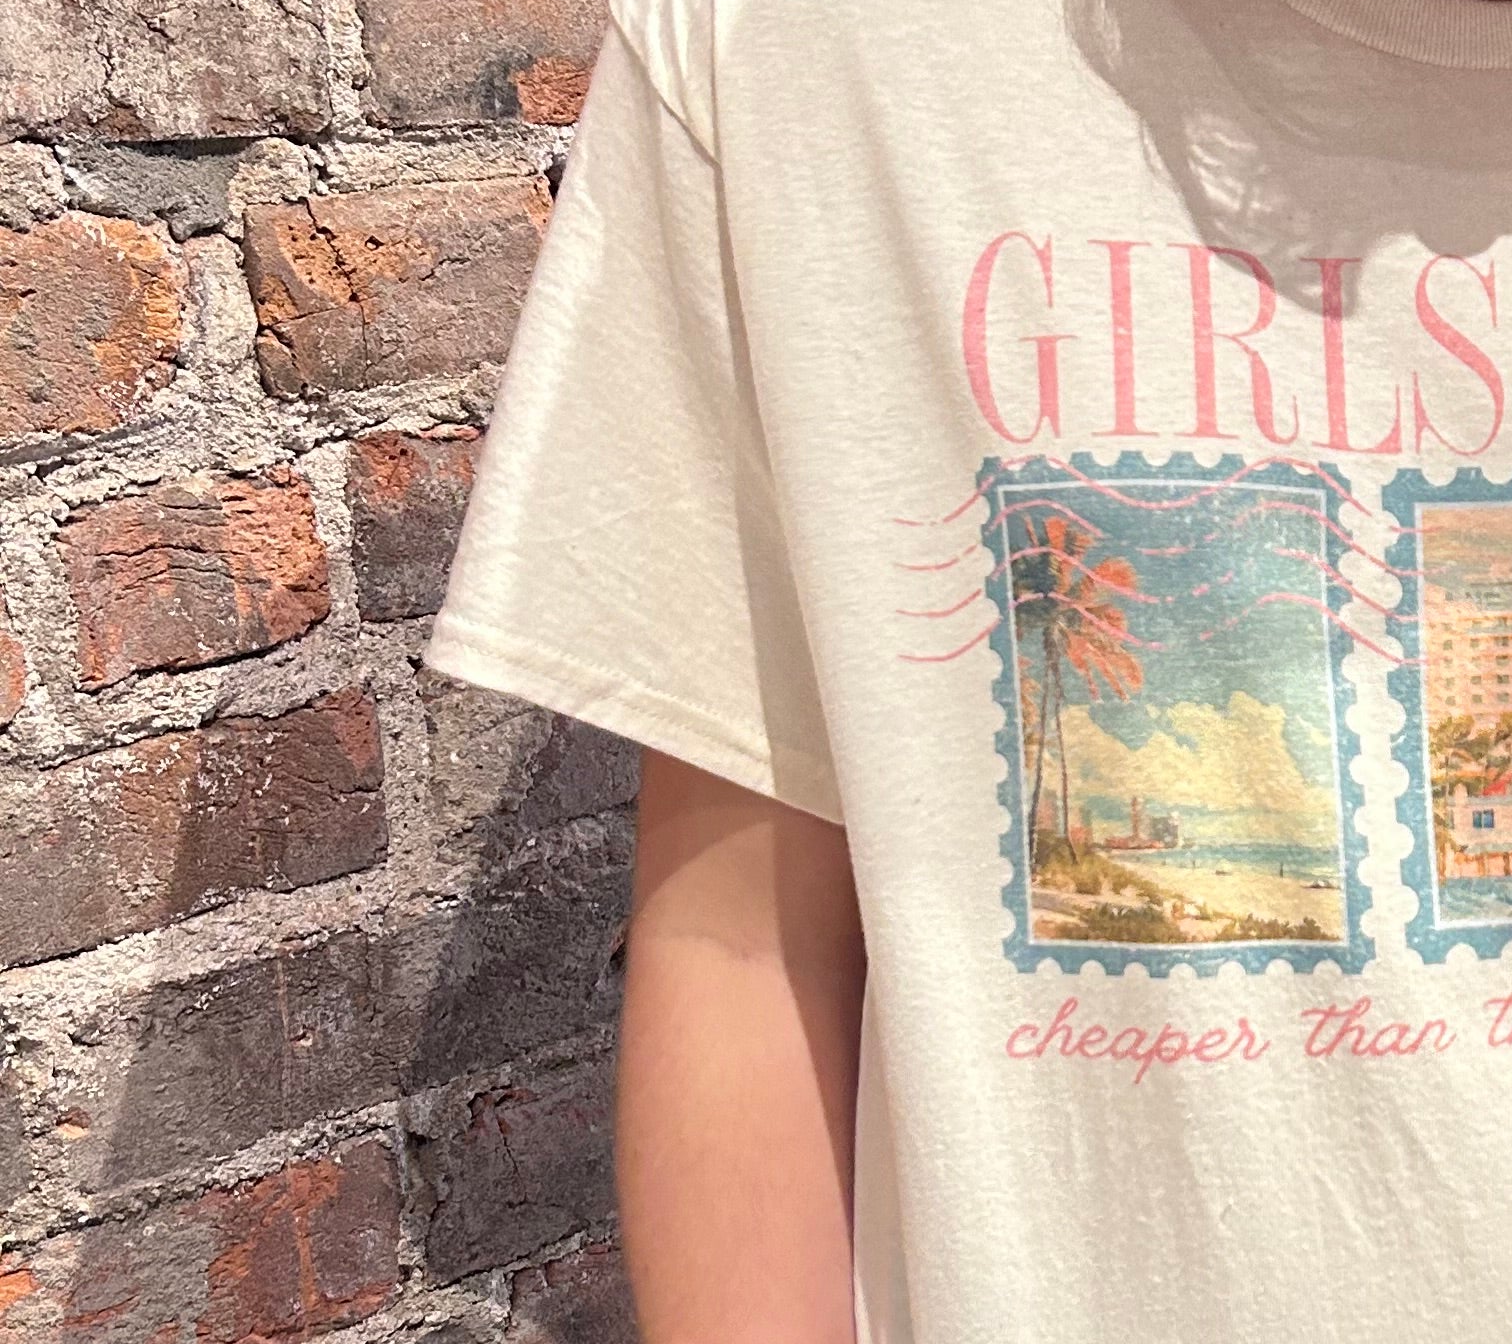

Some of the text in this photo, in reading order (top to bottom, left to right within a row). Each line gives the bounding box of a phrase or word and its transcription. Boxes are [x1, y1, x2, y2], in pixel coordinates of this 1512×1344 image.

[960, 229, 1507, 459] GIRLS
[1005, 996, 1269, 1084] cheaper
[1300, 996, 1455, 1057] than
